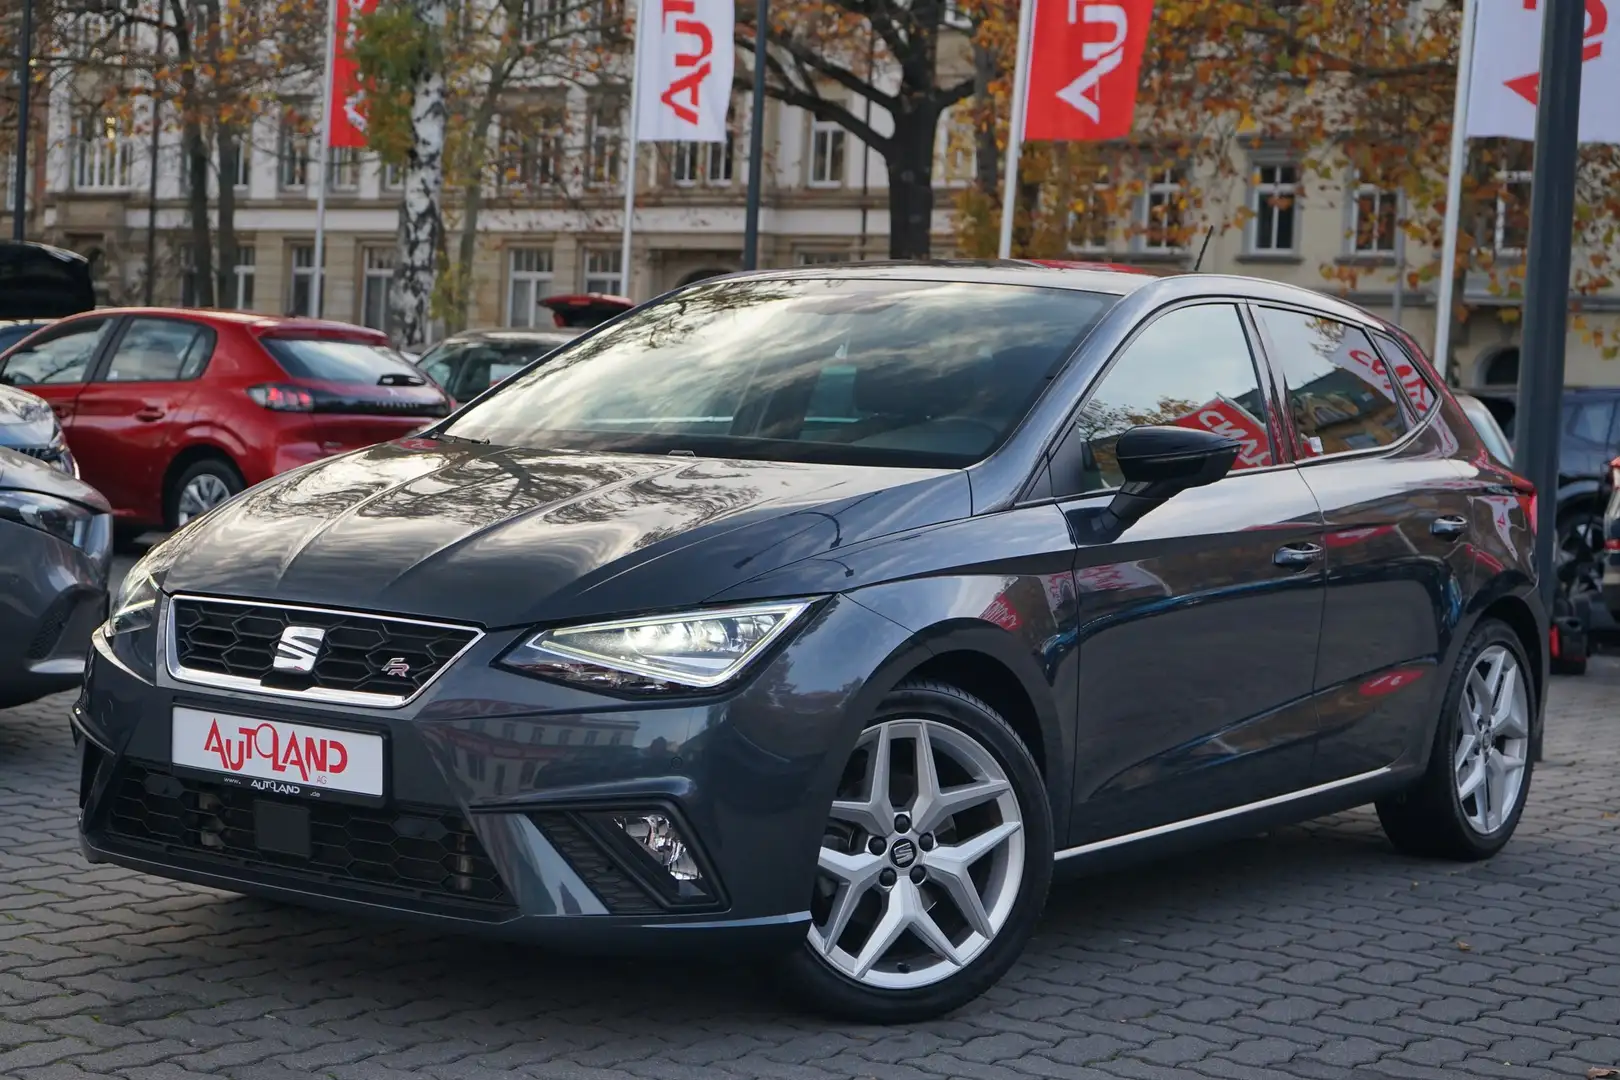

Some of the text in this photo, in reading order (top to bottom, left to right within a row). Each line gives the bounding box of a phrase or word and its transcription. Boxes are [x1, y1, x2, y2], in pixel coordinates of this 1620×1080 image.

[1055, 0, 1127, 124] AU
[381, 657, 410, 678] FR
[204, 717, 348, 782] AUTOLAND
[224, 777, 242, 785] www.
[251, 780, 300, 794] AUTOLAND
[316, 776, 327, 784] AG
